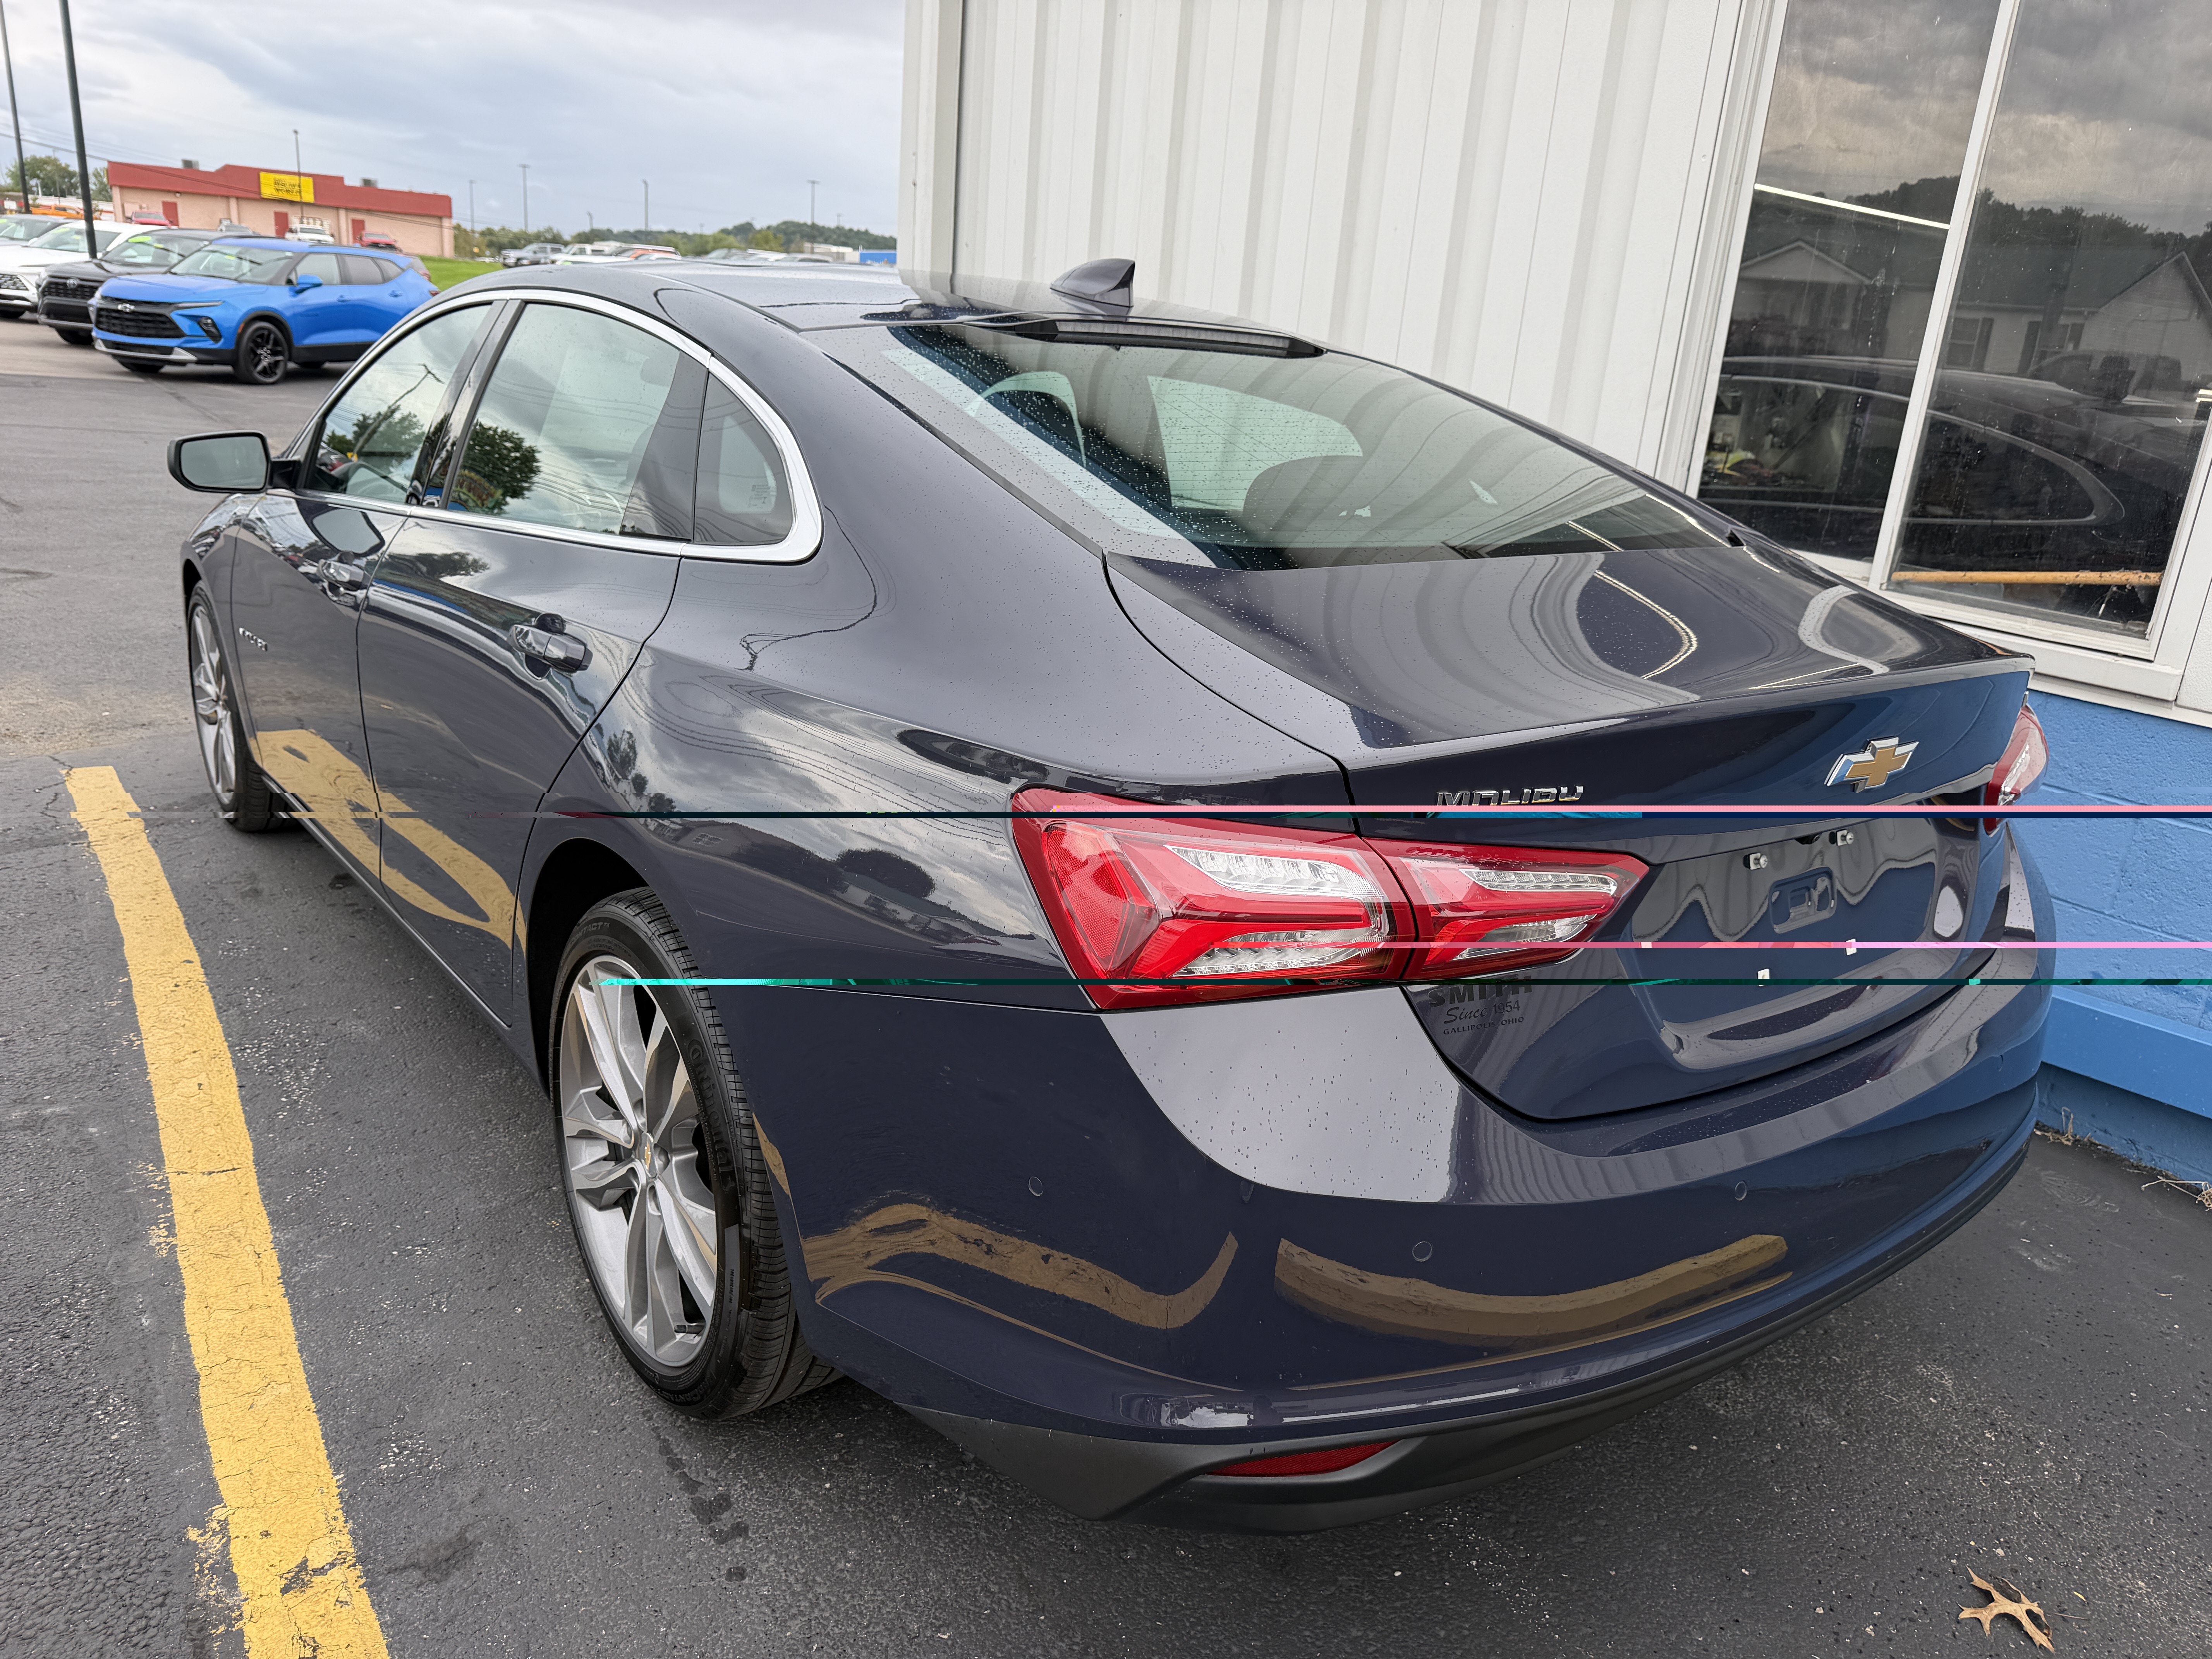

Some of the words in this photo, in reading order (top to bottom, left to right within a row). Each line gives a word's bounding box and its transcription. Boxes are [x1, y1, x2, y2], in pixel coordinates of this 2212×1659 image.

[1444, 1007, 1487, 1024] Since
[1493, 1000, 1520, 1015] 1954
[1501, 1016, 1524, 1025] OHIO
